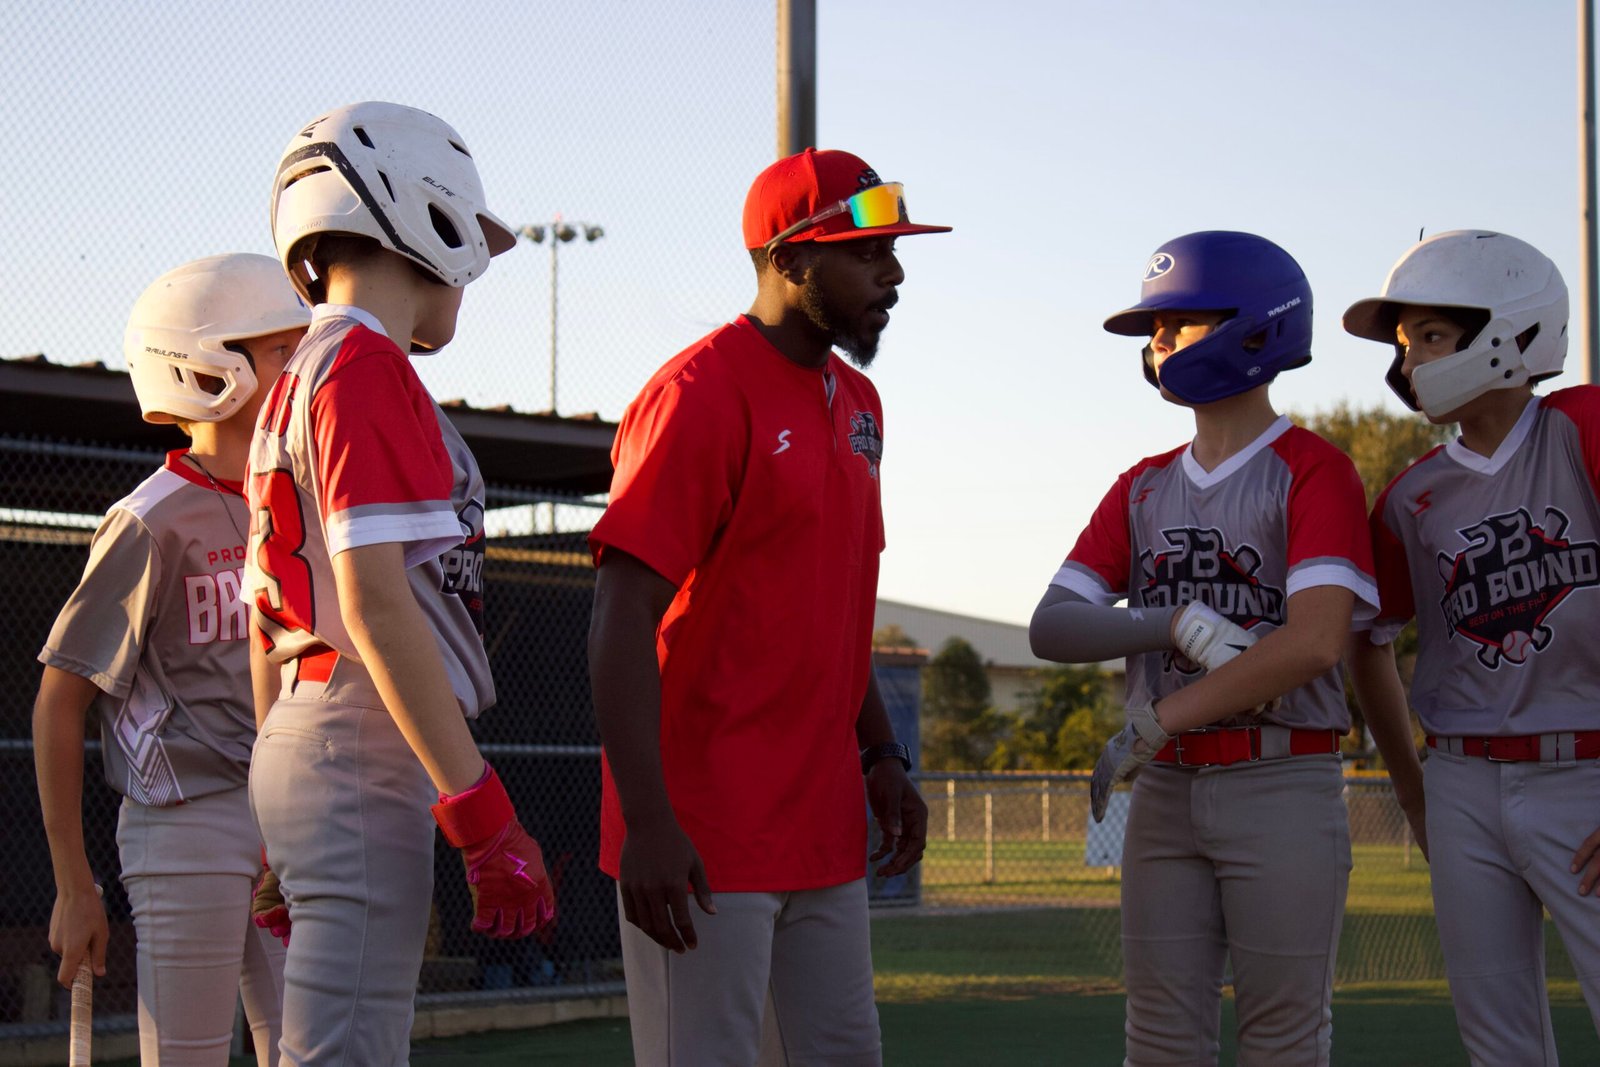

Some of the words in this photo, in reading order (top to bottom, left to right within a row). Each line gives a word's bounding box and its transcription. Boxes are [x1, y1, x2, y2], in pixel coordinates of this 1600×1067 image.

[422, 176, 456, 197] ELITE
[1267, 297, 1301, 317] RAWLINGS
[207, 546, 246, 566] PRO
[1167, 531, 1220, 579] PB
[1466, 512, 1532, 576] PB
[1486, 547, 1598, 607] BOUND
[184, 567, 250, 645] BA
[1491, 608, 1504, 620] ON
[1507, 603, 1526, 616] THE
